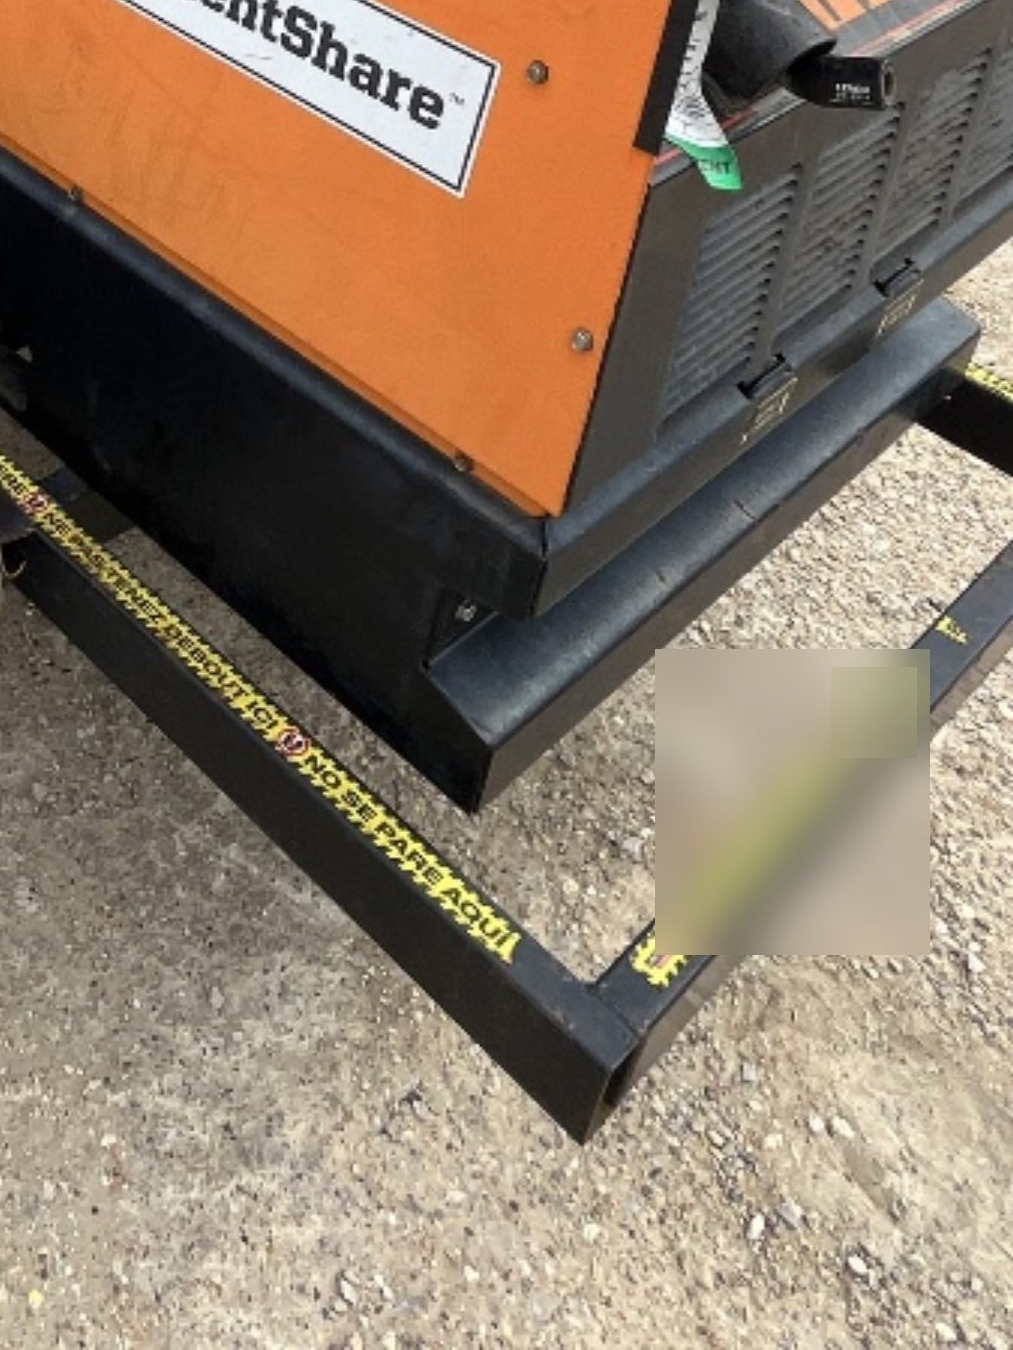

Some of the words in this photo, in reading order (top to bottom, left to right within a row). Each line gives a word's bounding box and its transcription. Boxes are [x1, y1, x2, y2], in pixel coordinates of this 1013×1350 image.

[166, 623, 247, 698] DEBOUT
[245, 699, 280, 730] ICI
[305, 755, 342, 789] NO
[341, 791, 376, 823] SE
[375, 823, 443, 885] PARE
